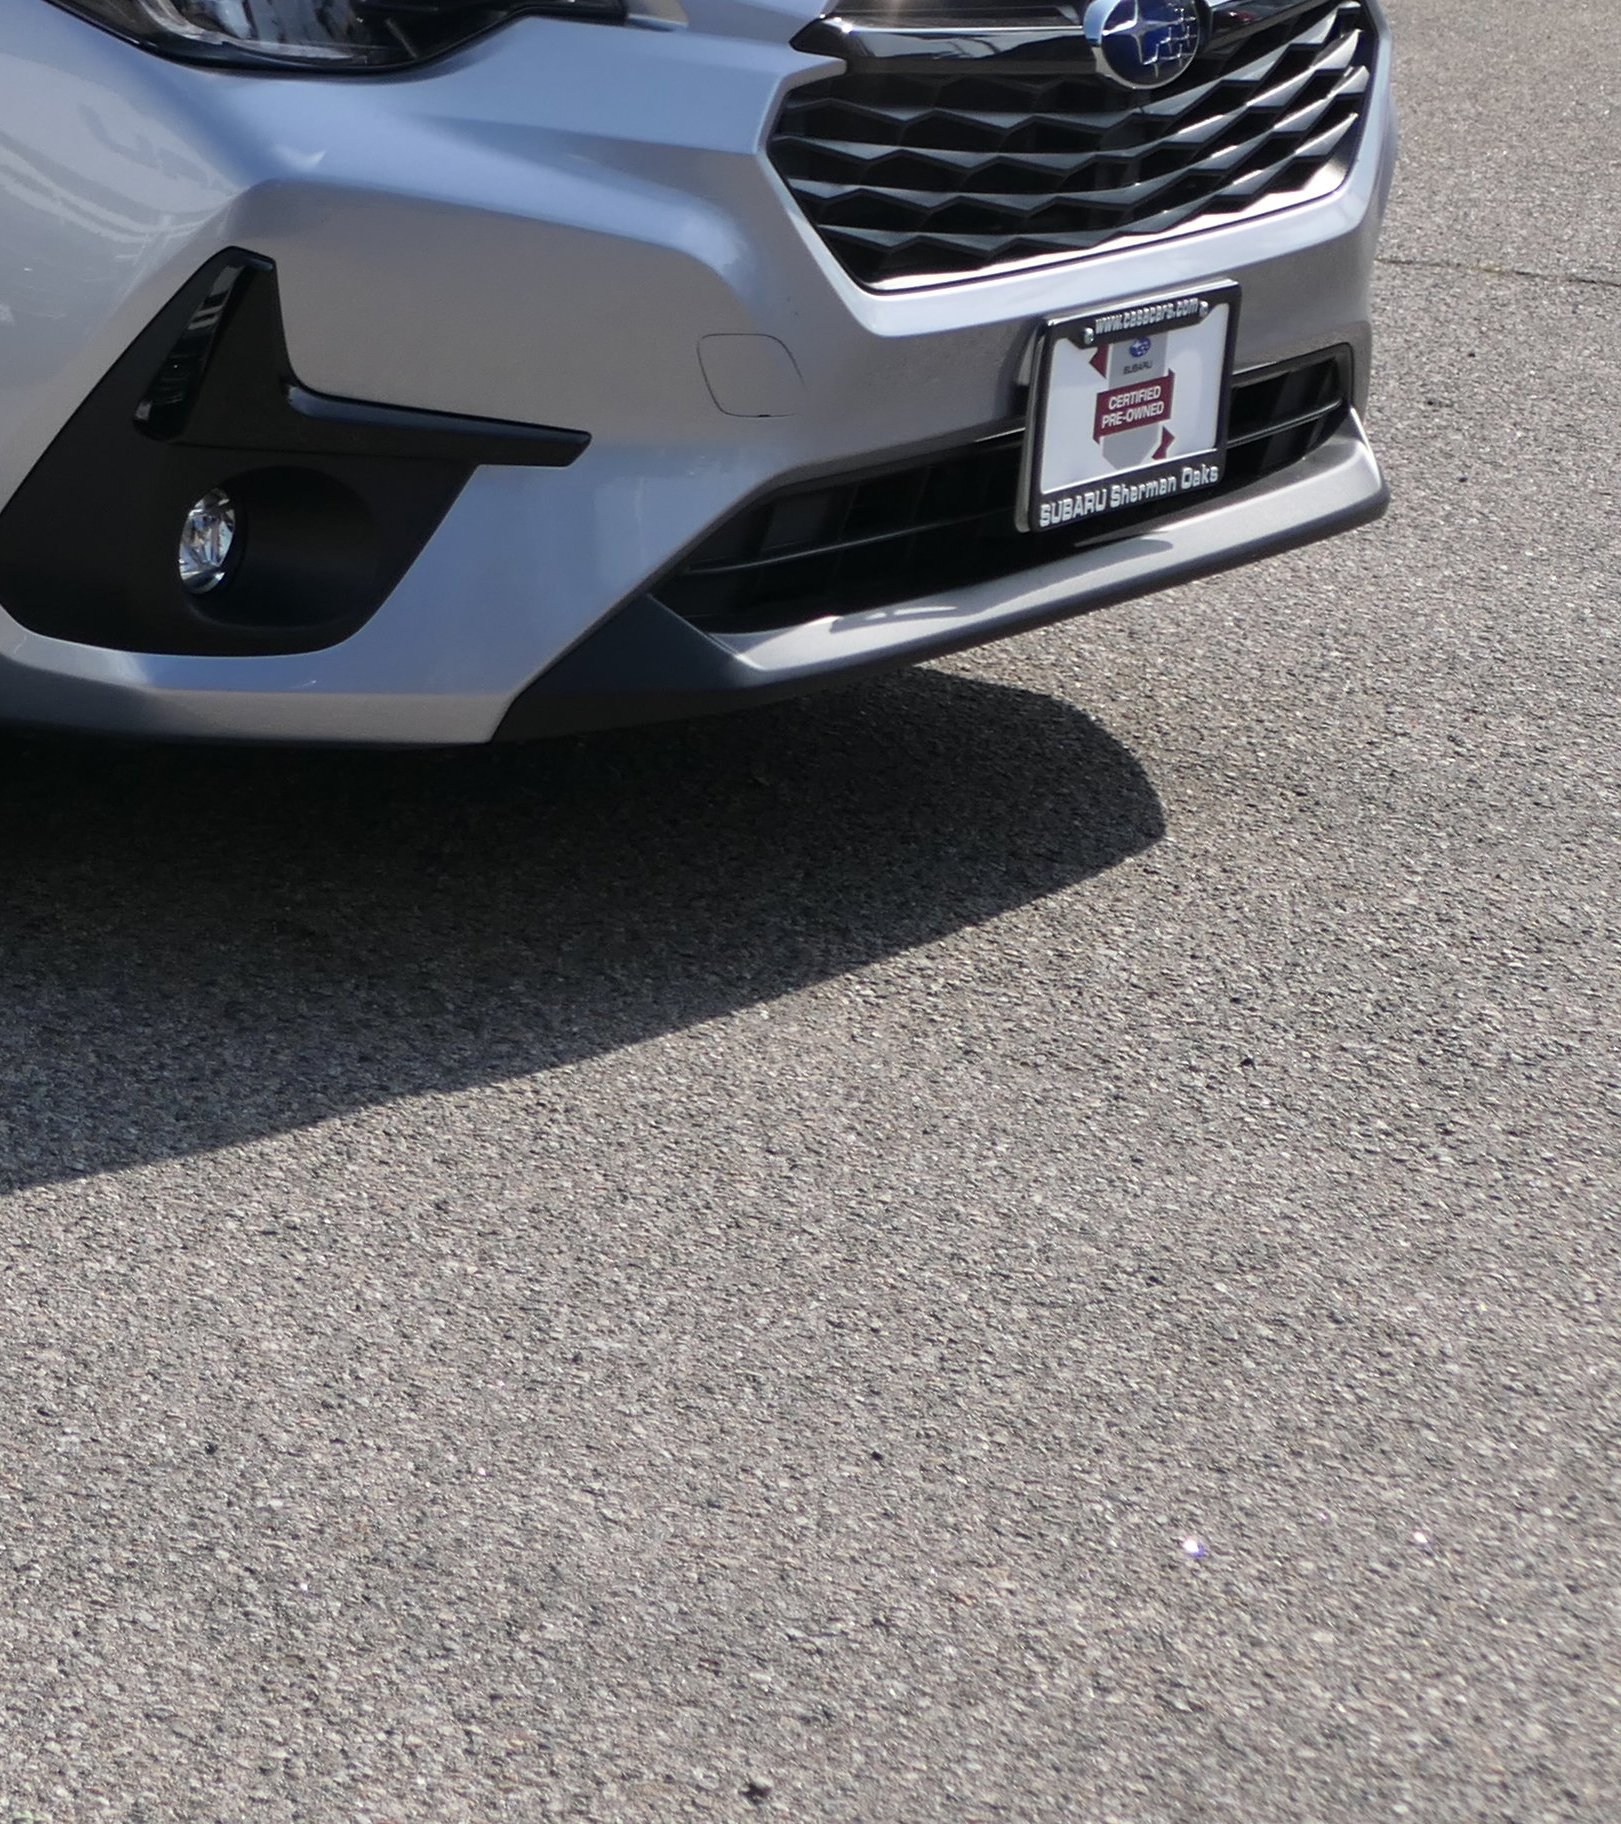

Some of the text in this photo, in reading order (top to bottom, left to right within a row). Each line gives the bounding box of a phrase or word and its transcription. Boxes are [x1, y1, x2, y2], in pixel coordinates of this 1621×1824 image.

[1095, 297, 1199, 334] www.casacars.com
[1123, 361, 1153, 375] SUBARU
[1108, 385, 1161, 410] CERTIFIED
[1101, 401, 1165, 428] PRE-OWNED
[1039, 464, 1219, 527] SUBARU Sherman Oaks
